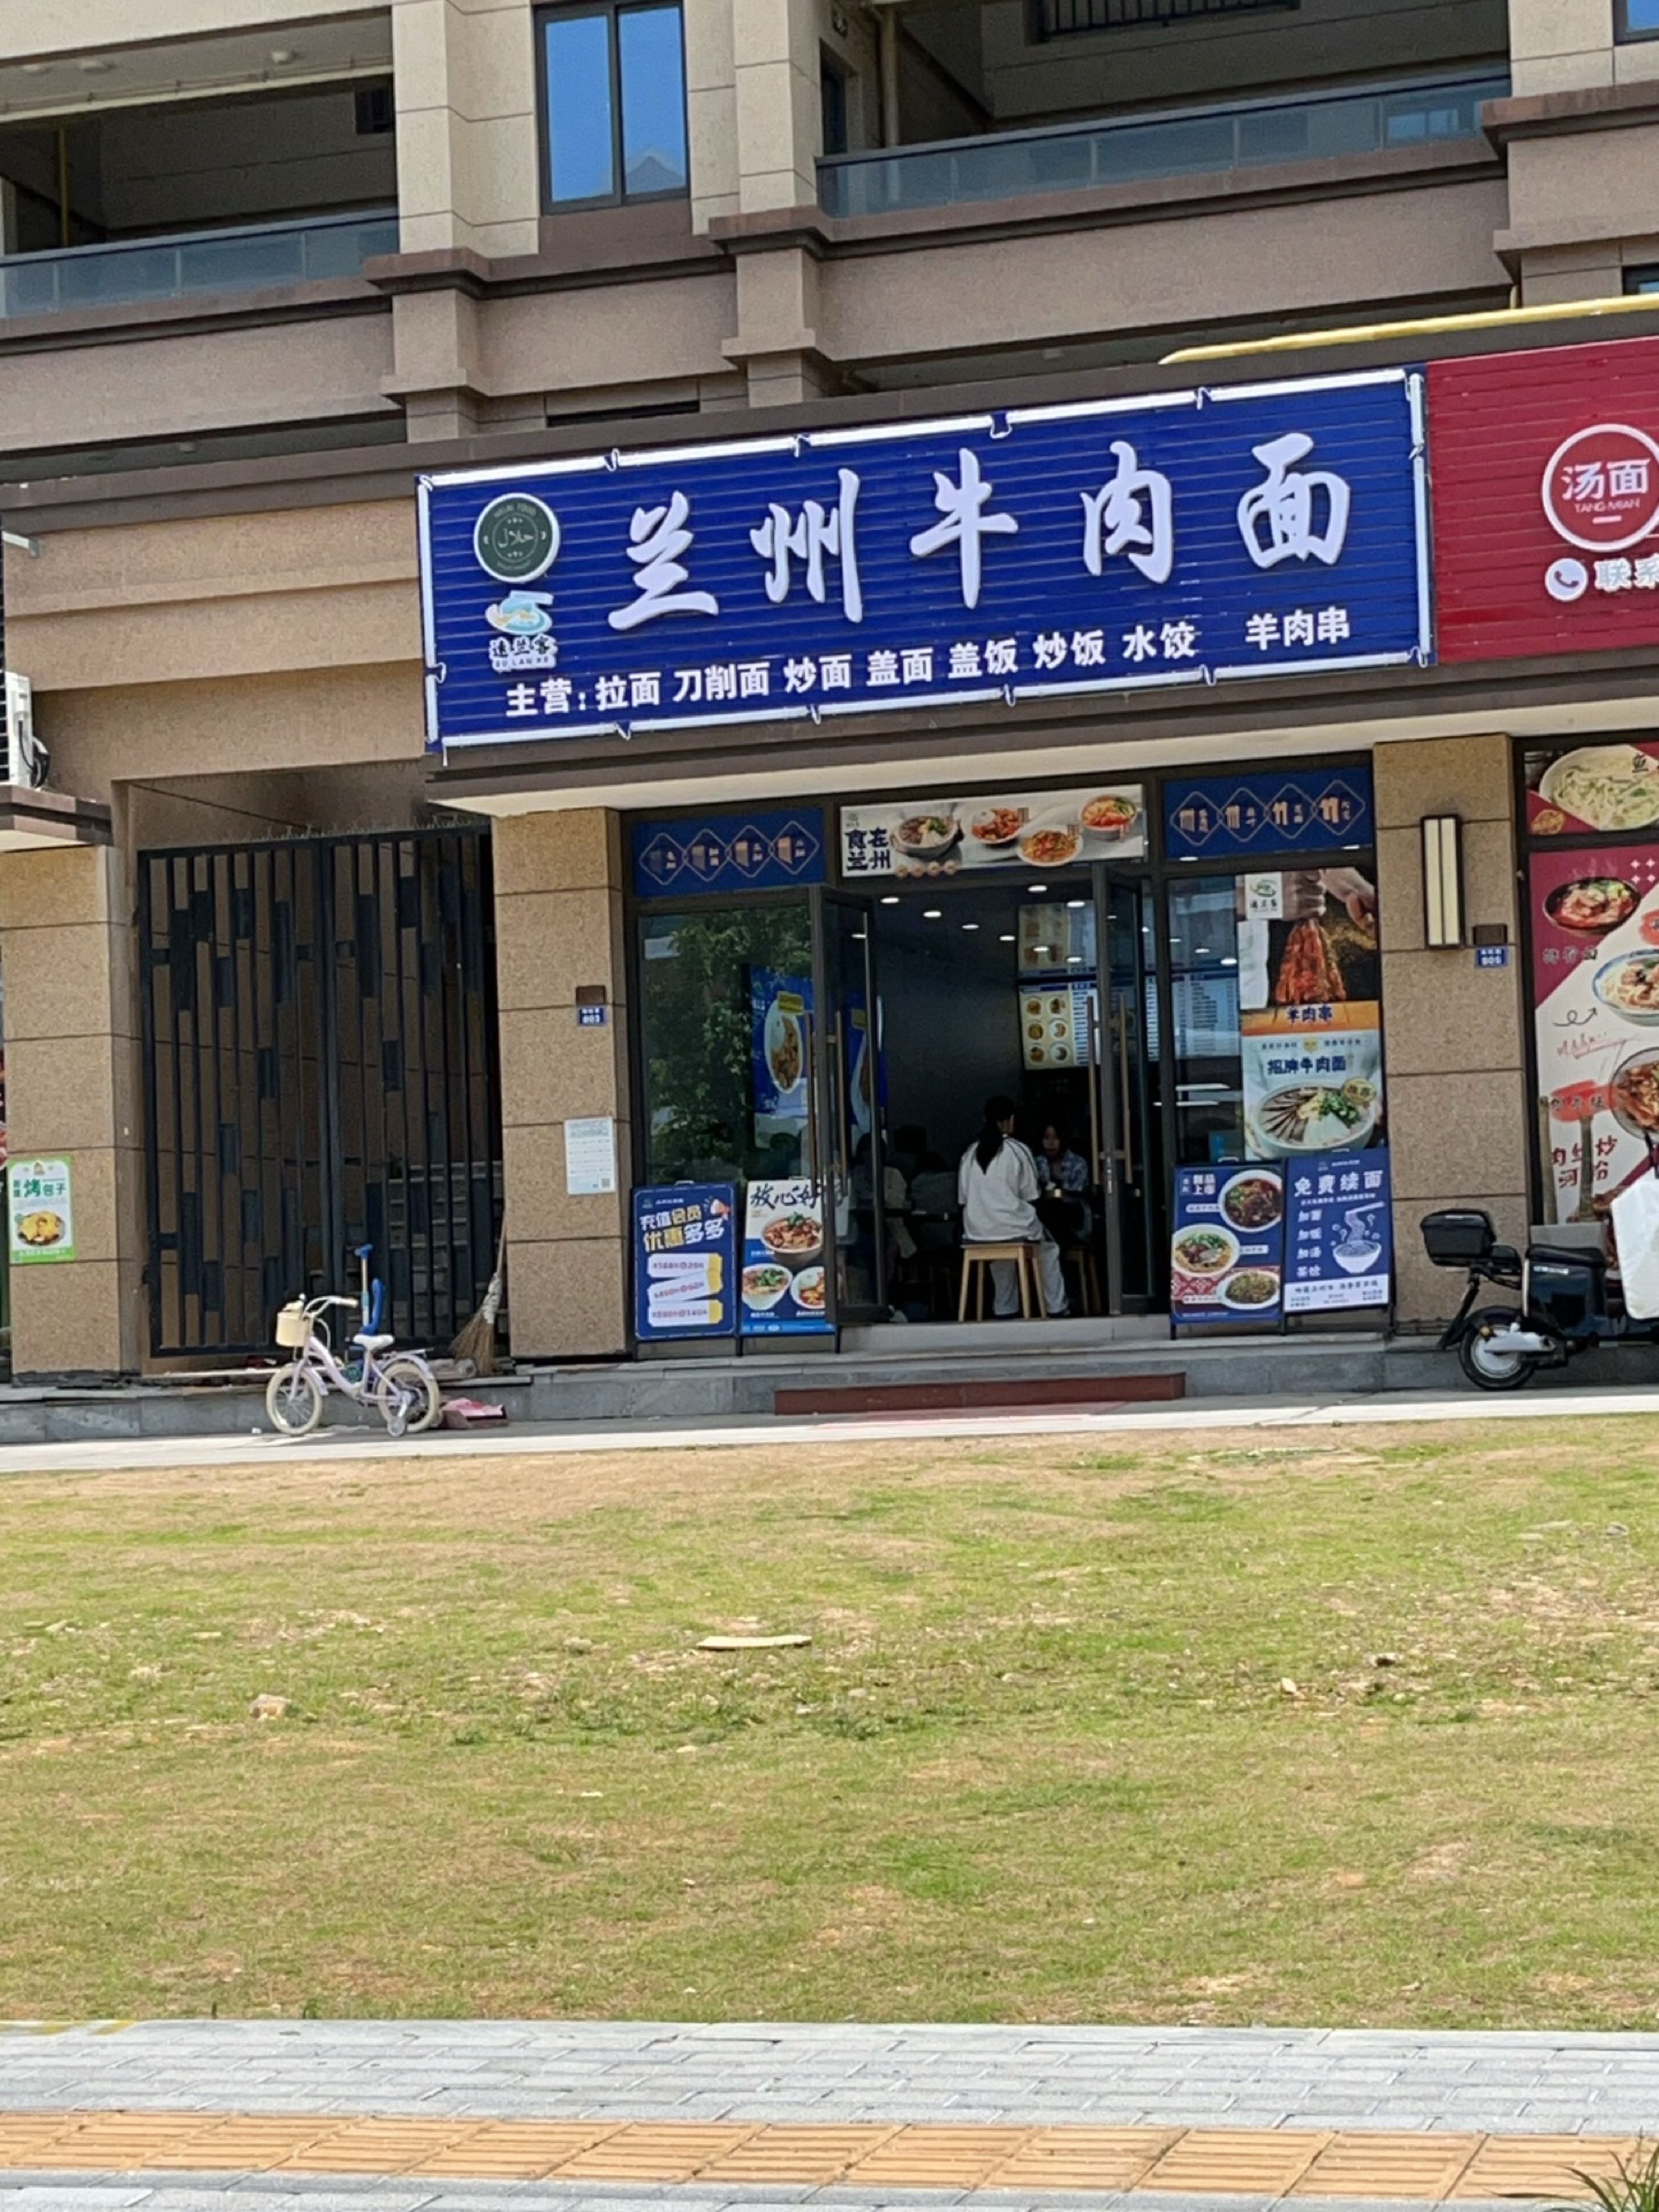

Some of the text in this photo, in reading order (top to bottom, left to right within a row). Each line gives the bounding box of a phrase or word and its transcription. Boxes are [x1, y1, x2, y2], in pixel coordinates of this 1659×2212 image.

[1561, 457, 1650, 501] 汤面
[607, 433, 1351, 630] 兰州牛肉面
[673, 660, 772, 701] 刀削面
[783, 655, 851, 692] 炒面
[866, 648, 933, 685] 盖面
[949, 638, 1018, 678] 盖饭
[1033, 630, 1105, 668] 炒饭
[1123, 622, 1196, 661] 水饺
[1246, 607, 1349, 649] 羊肉串
[1267, 1055, 1346, 1075] 招牌牛肉面
[644, 1218, 725, 1252] 优惠多多
